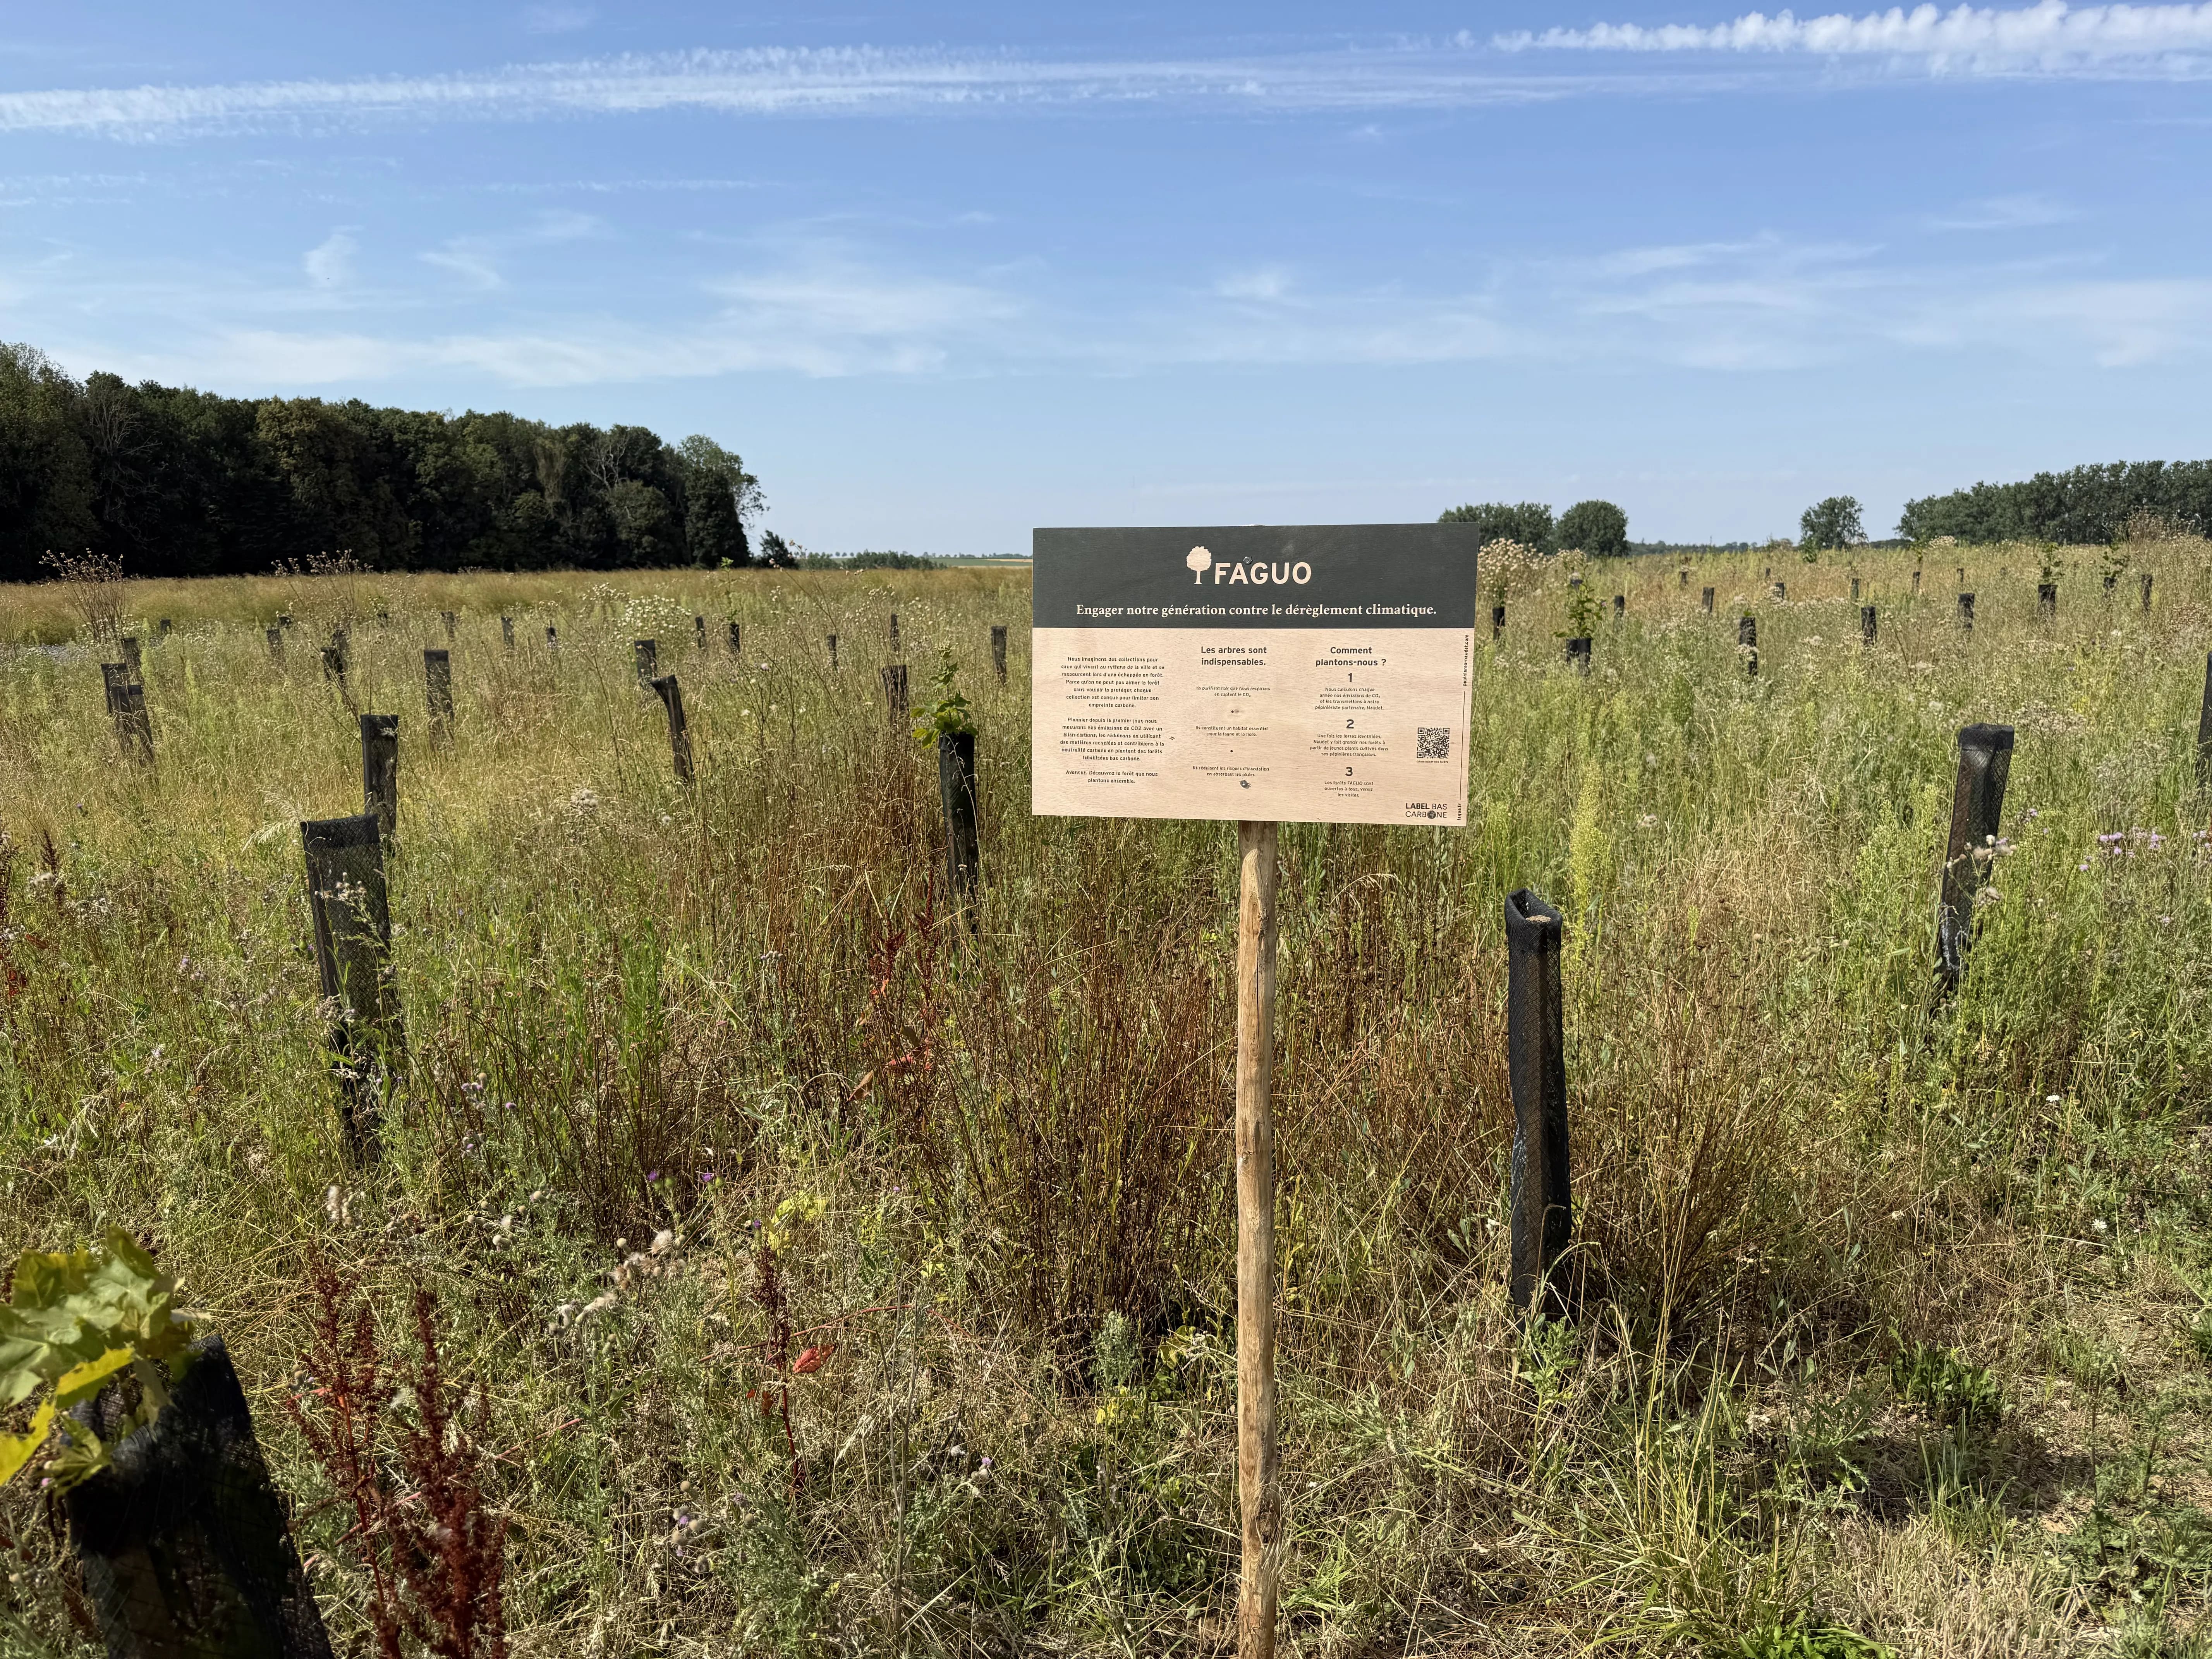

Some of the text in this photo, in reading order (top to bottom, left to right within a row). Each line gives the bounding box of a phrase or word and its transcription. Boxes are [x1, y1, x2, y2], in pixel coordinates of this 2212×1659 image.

[1215, 562, 1312, 585] FAGUO
[1076, 604, 1436, 618] Engager notre génération contre le dérèglement climatique.
[1202, 658, 1266, 667] indispensables.
[1316, 658, 1378, 667] plantons-nous
[1348, 673, 1352, 682] 1
[1346, 719, 1354, 728] 2
[1345, 767, 1353, 776] 3
